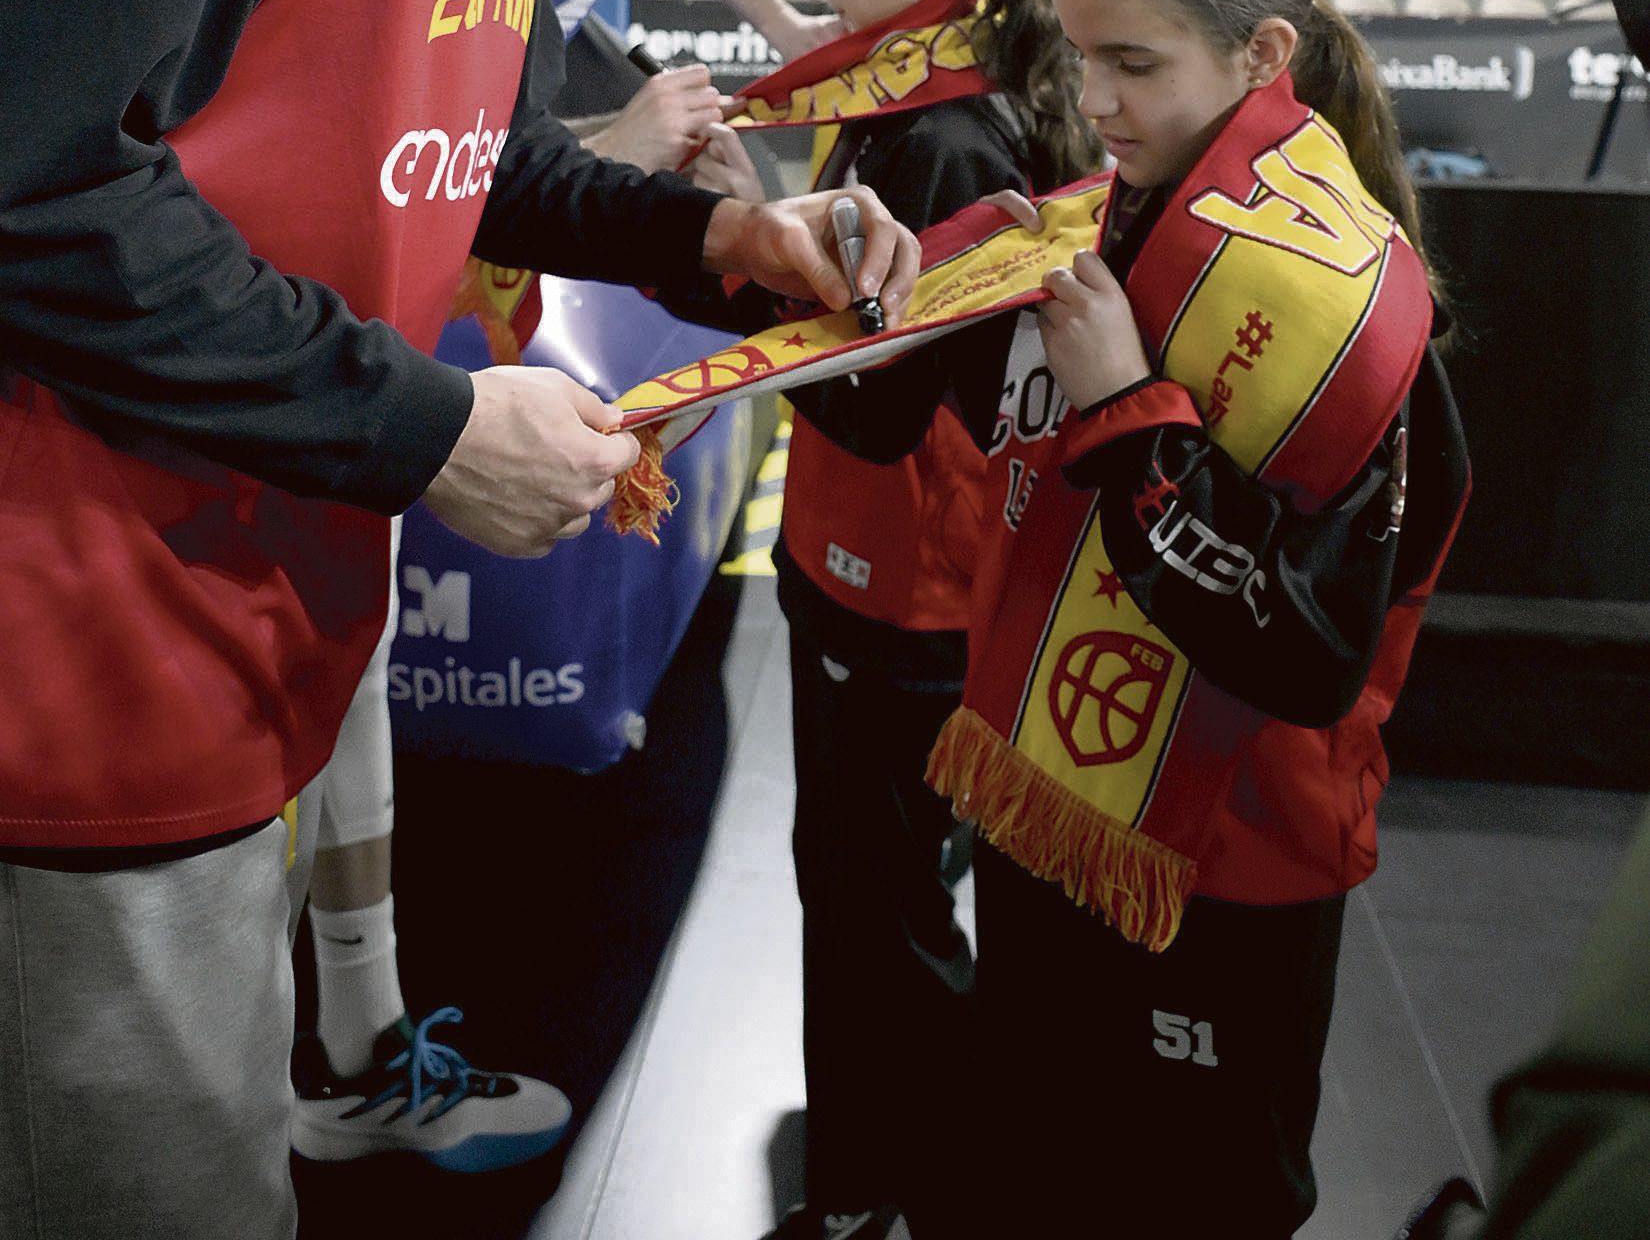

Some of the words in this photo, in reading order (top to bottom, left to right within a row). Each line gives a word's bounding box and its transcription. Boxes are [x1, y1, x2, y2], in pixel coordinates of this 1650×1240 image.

[380, 109, 510, 208] endes
[387, 656, 585, 712] spitales
[1130, 642, 1165, 672] FEB
[1152, 1008, 1219, 1068] 51
